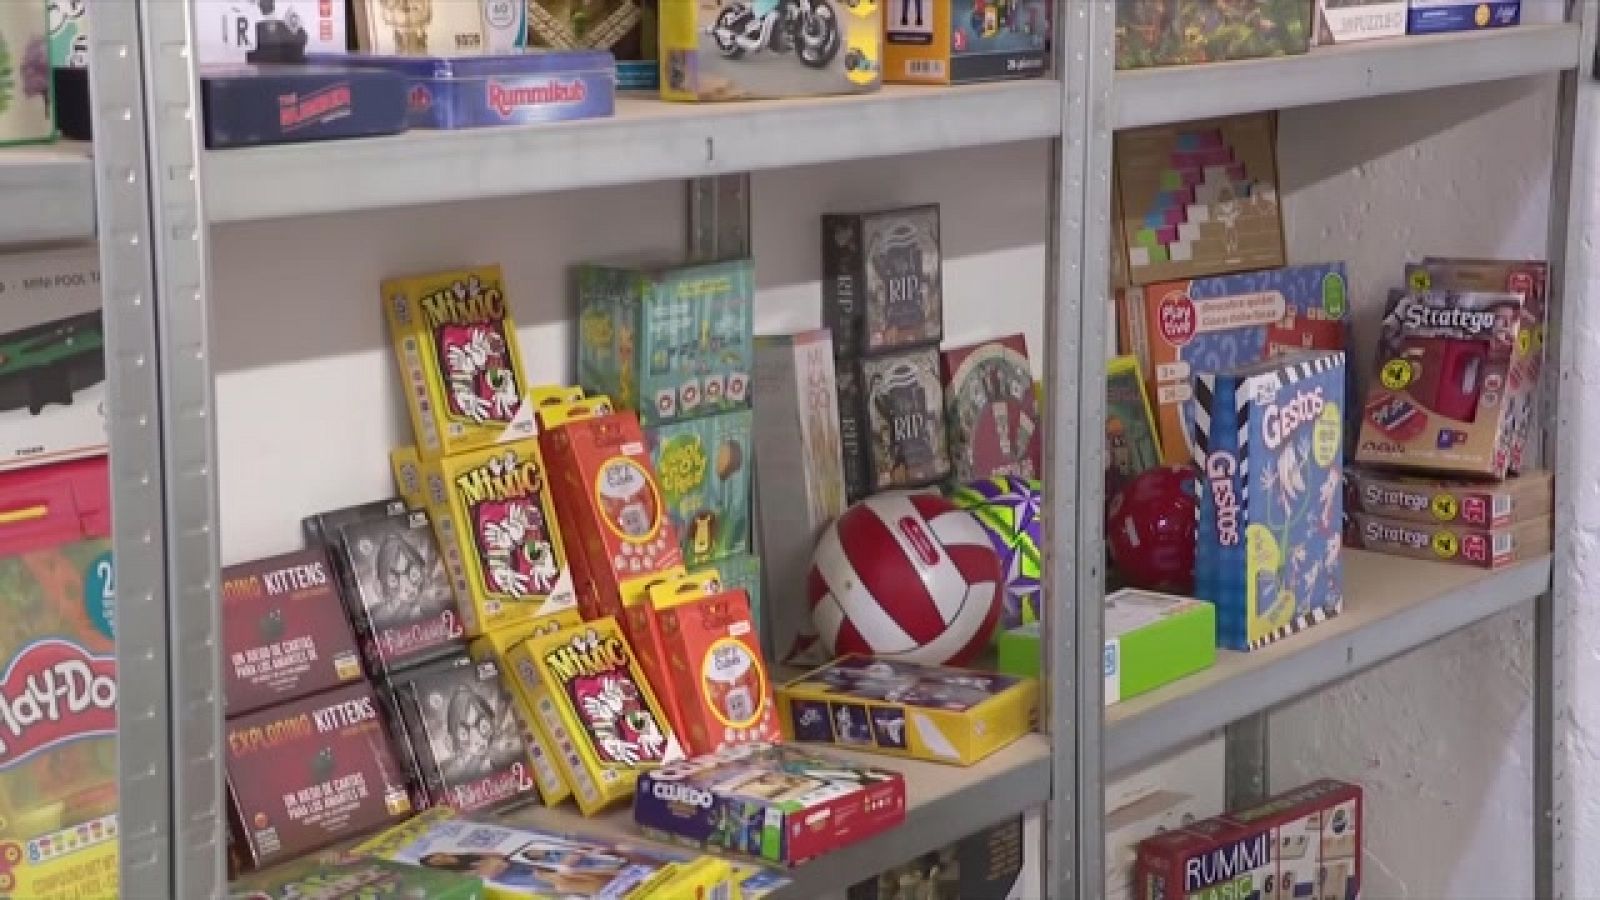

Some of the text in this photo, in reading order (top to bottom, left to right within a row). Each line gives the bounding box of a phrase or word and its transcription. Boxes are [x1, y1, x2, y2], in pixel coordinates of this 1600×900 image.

[54, 271, 86, 287] POOL
[1405, 303, 1495, 335] Stratego
[1366, 484, 1429, 511] Stratego
[1366, 521, 1429, 548] Stratego
[263, 562, 326, 596] KITTENS
[229, 697, 376, 759] EXPLODING KITTENS
[652, 781, 714, 809] CLUEDO
[1186, 833, 1267, 892] RUMMI
